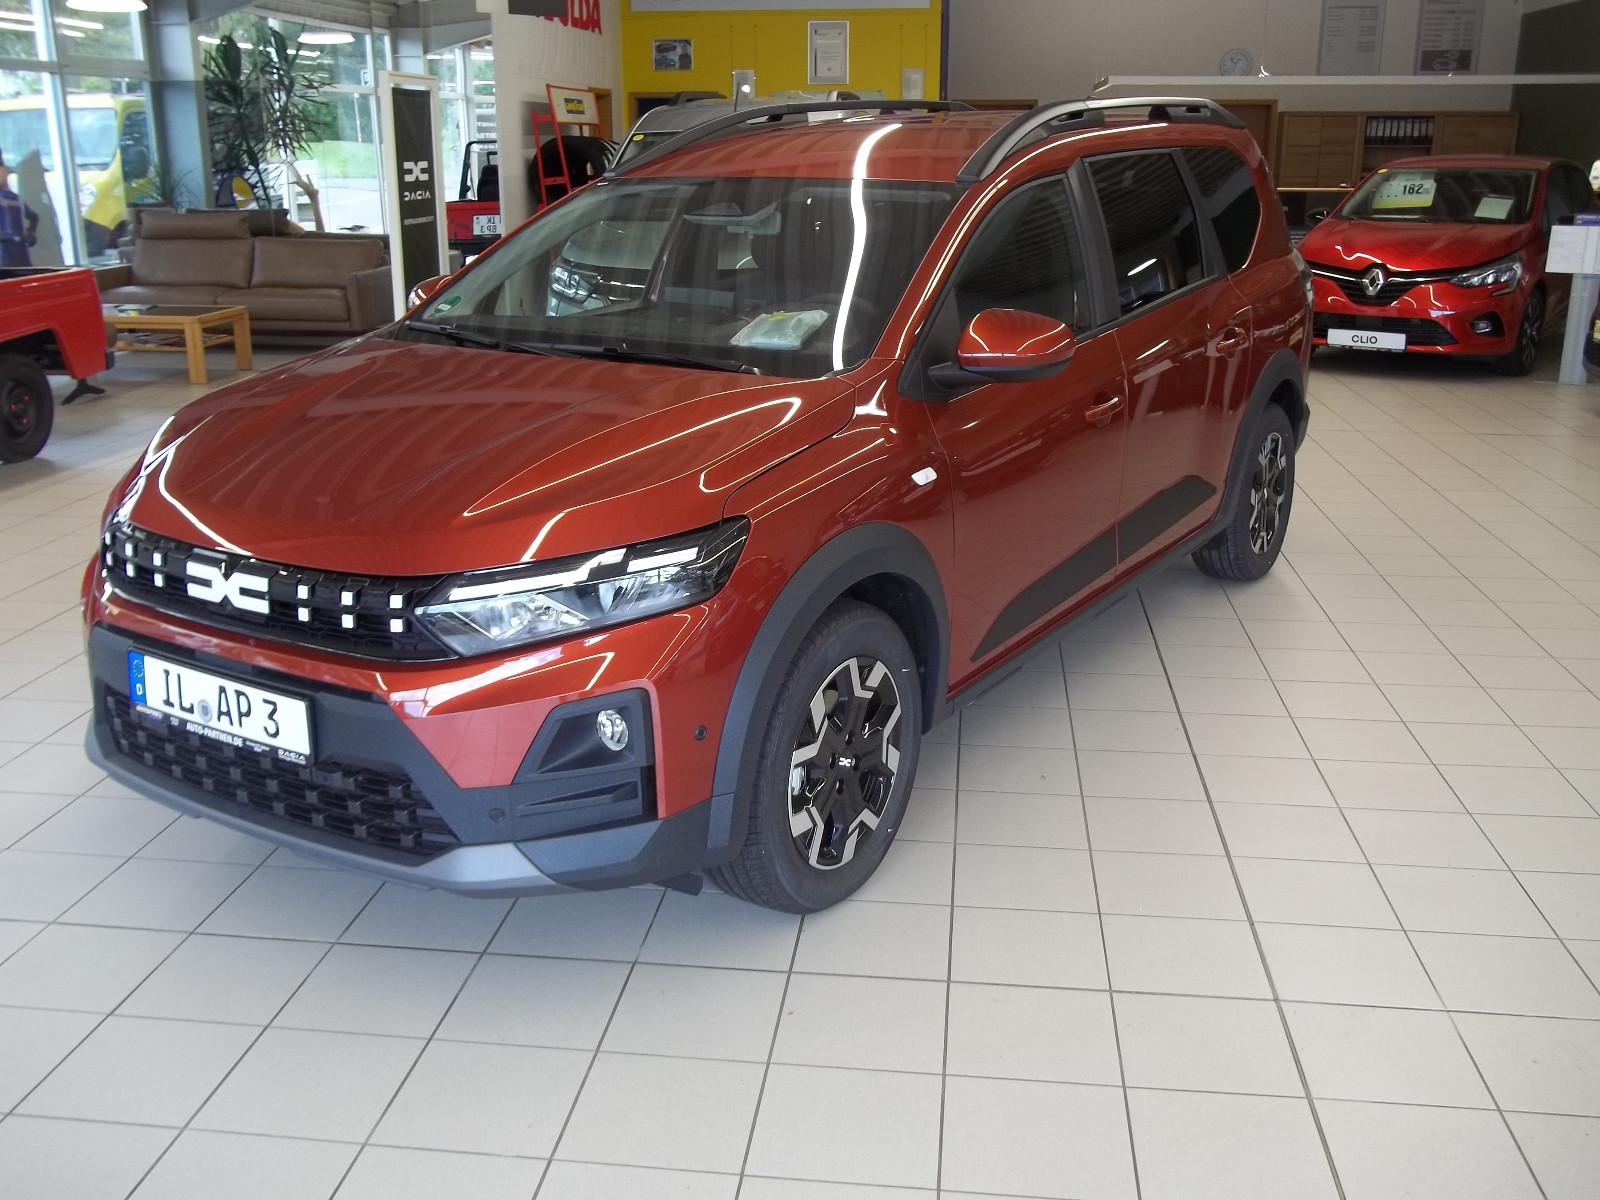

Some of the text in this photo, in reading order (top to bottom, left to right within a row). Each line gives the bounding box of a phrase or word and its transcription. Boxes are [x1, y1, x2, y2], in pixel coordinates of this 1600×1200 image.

[1403, 183, 1424, 195] 182
[403, 190, 431, 201] DACIA
[1351, 334, 1378, 345] CLIO
[163, 669, 280, 739] IL AP 3
